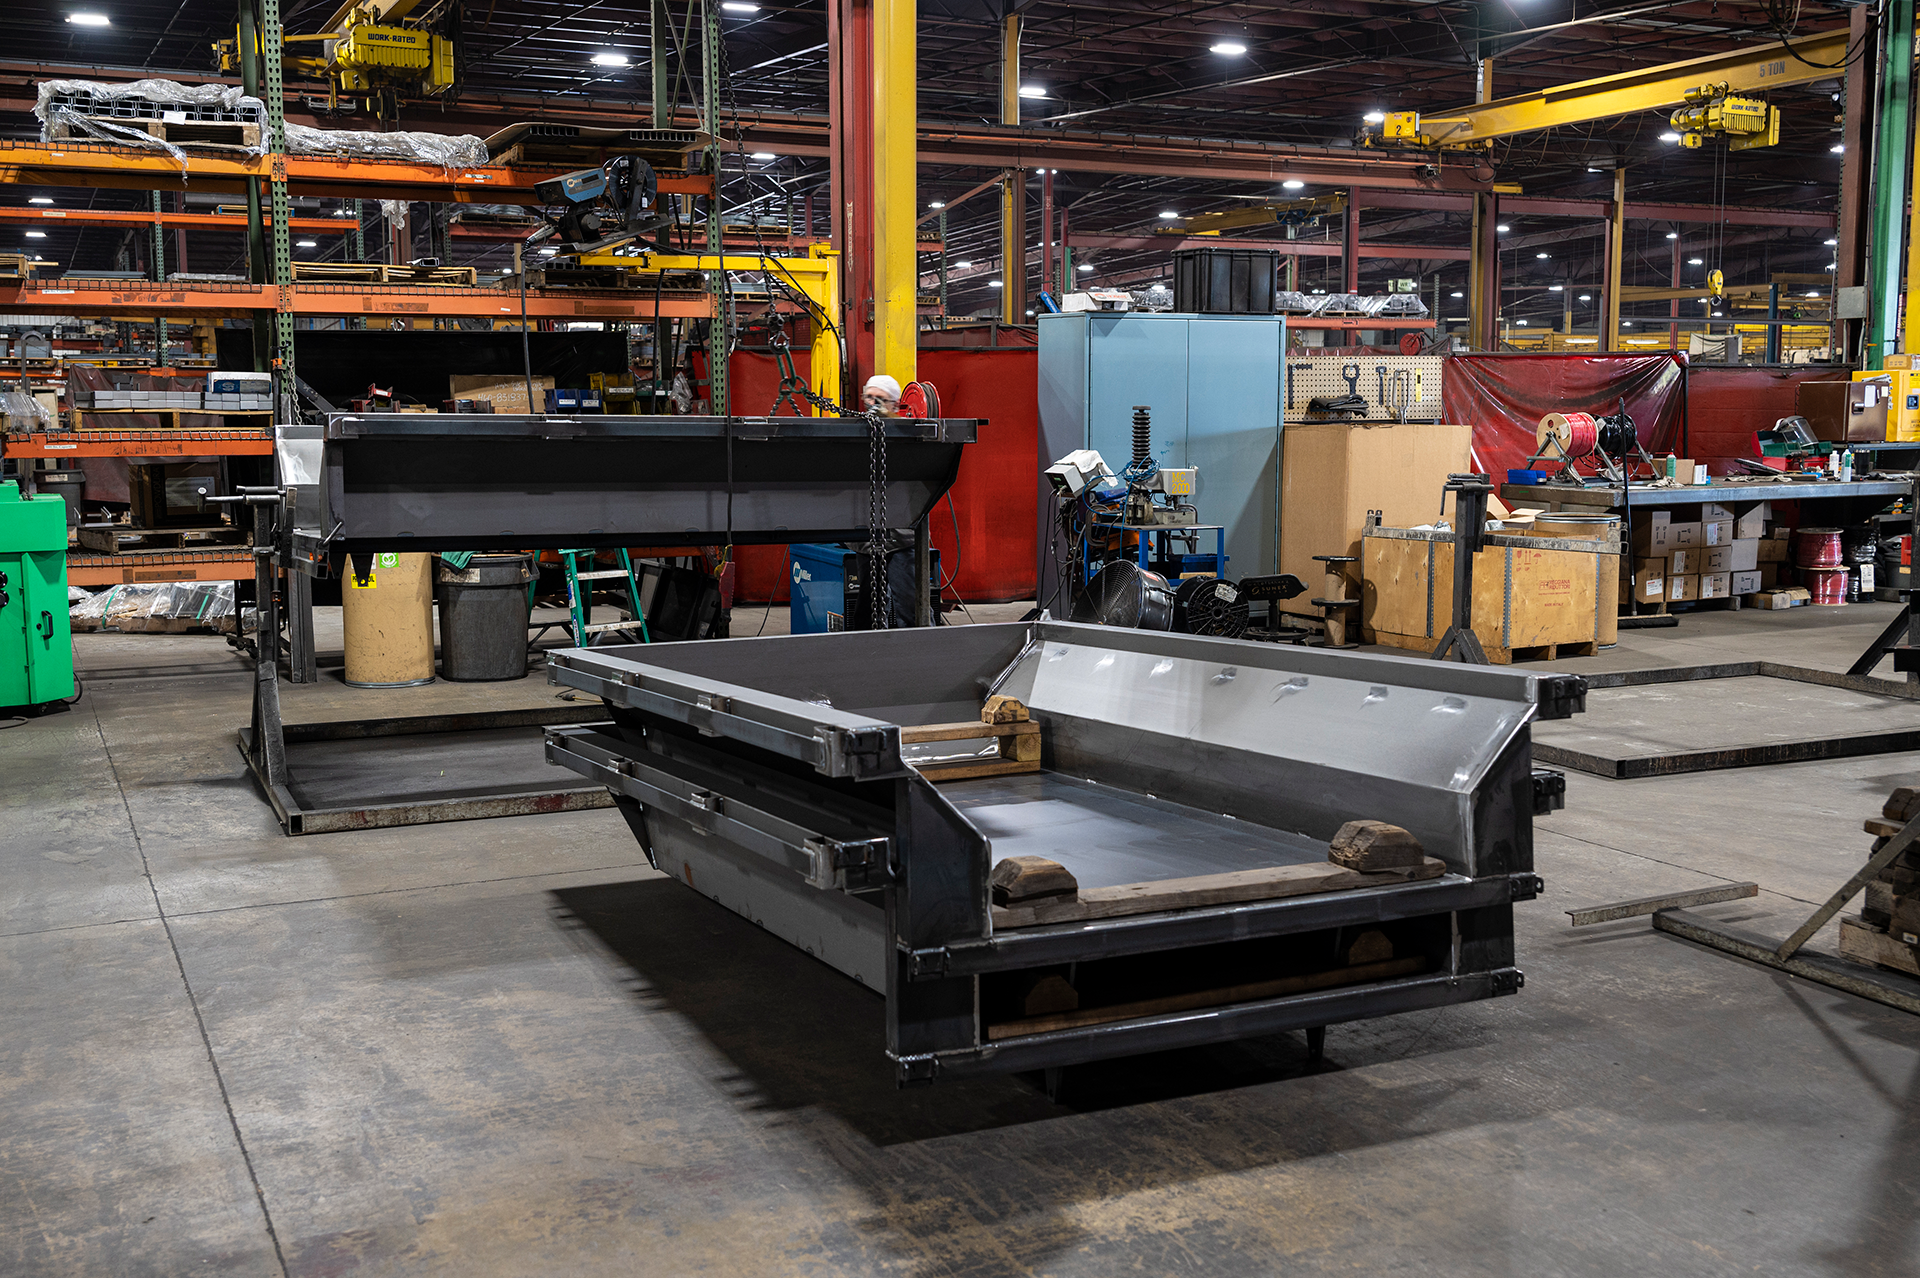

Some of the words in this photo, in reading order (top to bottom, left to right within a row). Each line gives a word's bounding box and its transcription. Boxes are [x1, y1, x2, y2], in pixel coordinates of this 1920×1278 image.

[1760, 64, 1766, 77] 5
[1768, 61, 1785, 76] TON
[1396, 124, 1401, 135] 2
[1171, 472, 1186, 483] MC
[1171, 483, 1190, 494] 2000
